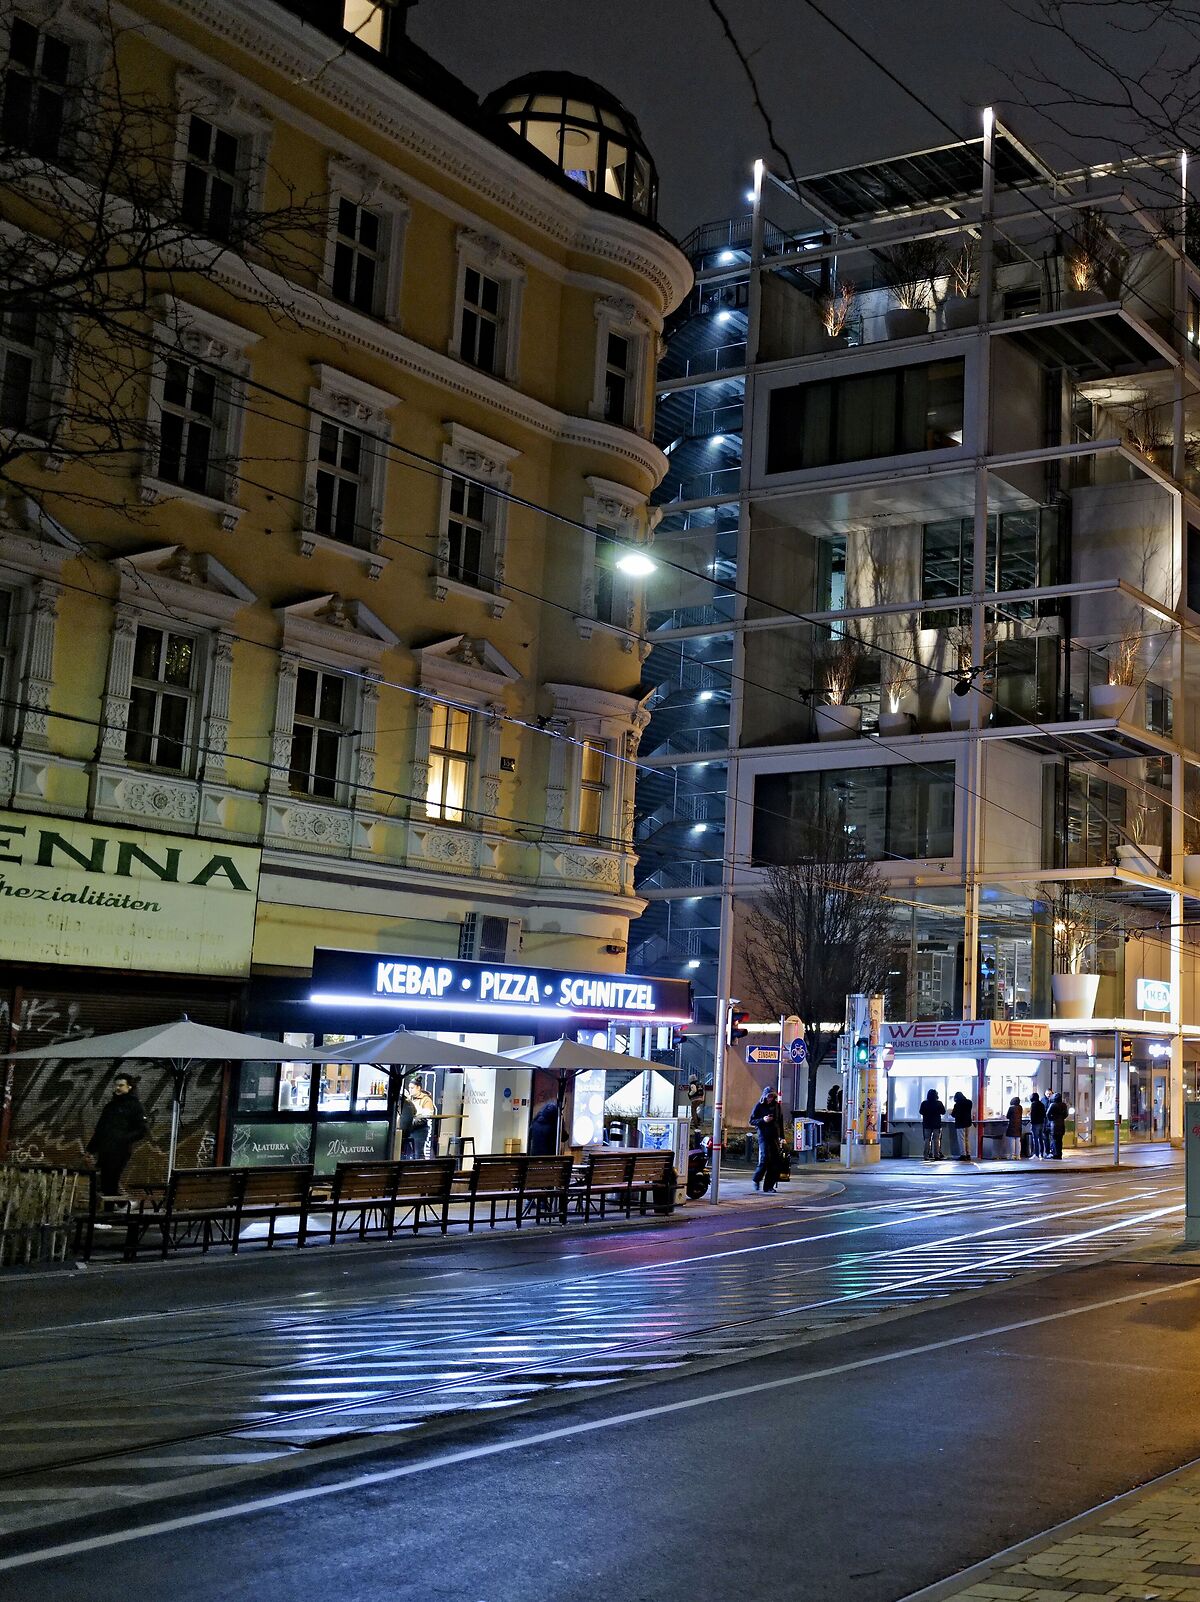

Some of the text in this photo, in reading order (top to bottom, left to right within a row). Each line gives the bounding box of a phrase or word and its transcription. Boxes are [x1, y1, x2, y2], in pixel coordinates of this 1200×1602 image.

[377, 962, 656, 1011] KEBAP PIZZA SCHNITZEL
[1145, 990, 1168, 1001] IKEA
[888, 1022, 985, 1038] WEST
[993, 1022, 1047, 1038] WEST
[959, 1038, 985, 1046] KEBAP
[758, 1051, 777, 1059] EINBAHN
[252, 1143, 290, 1153] ALATURKA
[341, 1145, 375, 1153] ALATURKA
